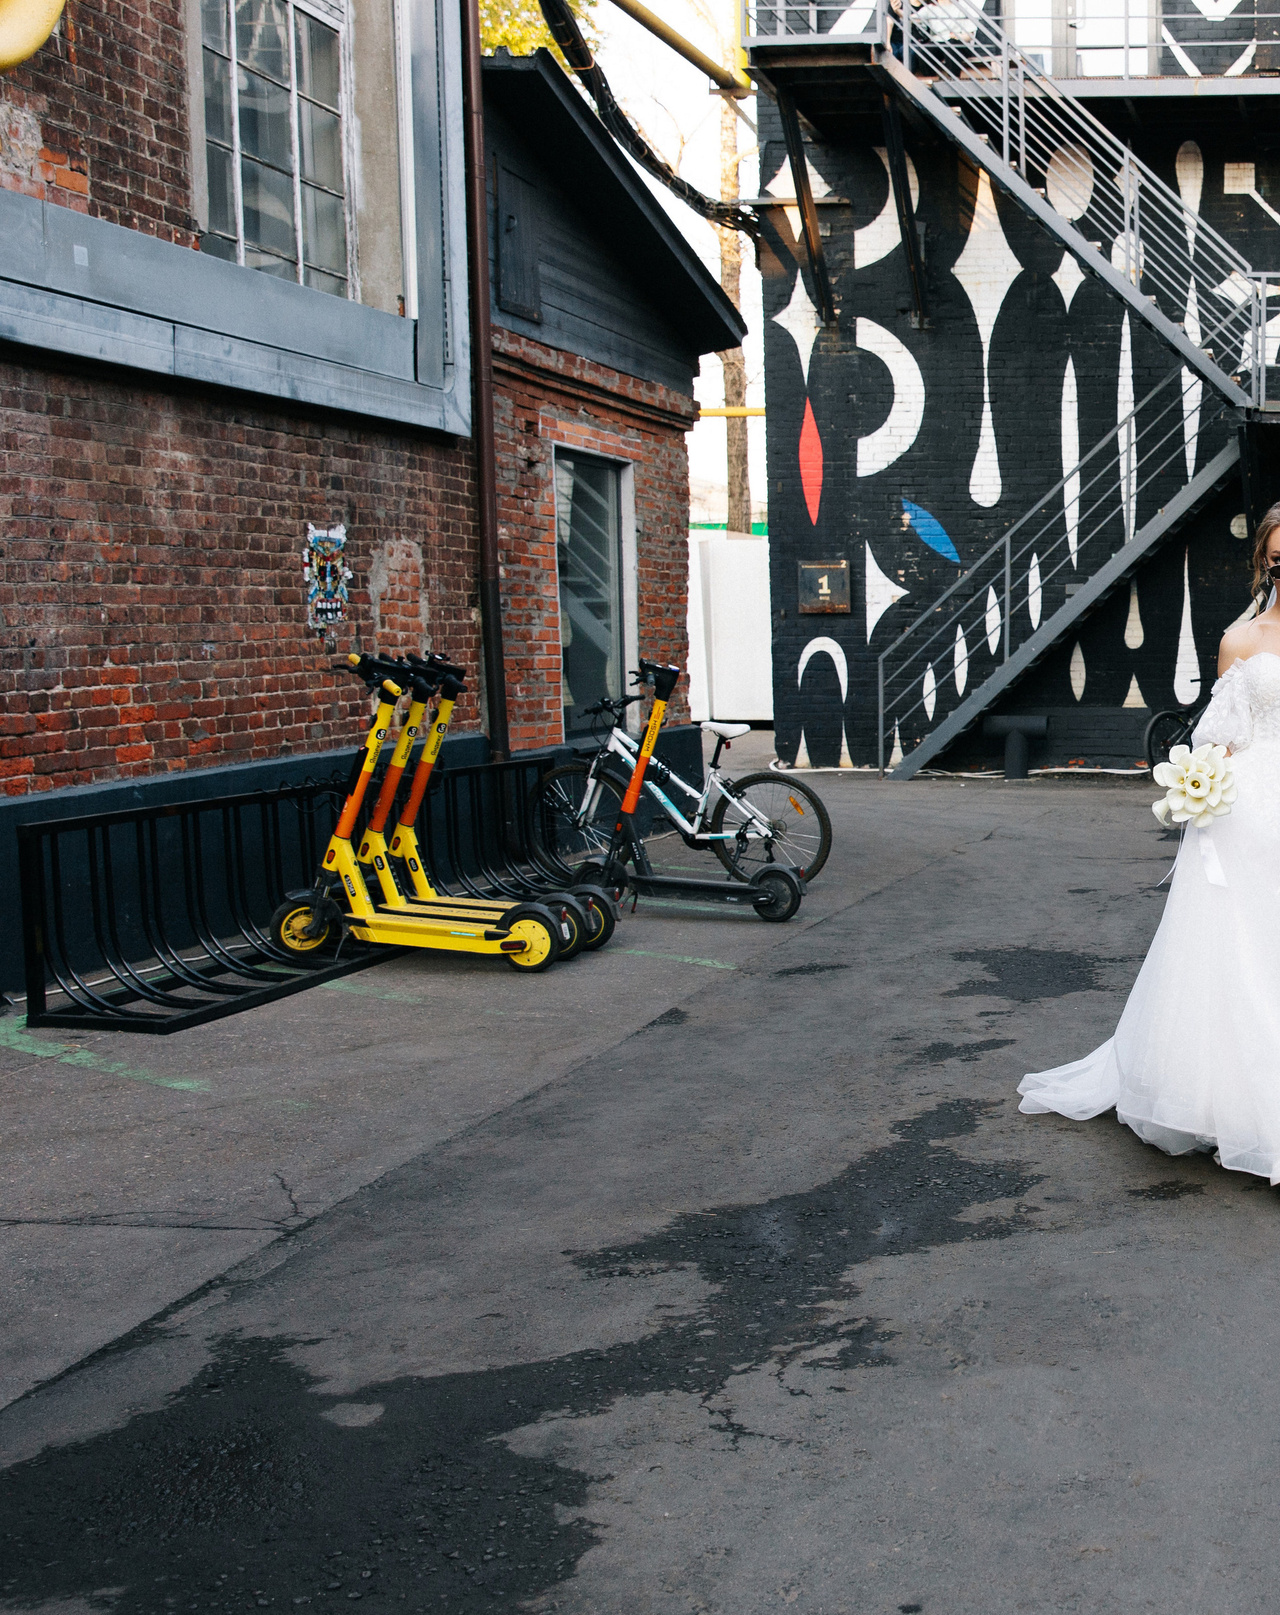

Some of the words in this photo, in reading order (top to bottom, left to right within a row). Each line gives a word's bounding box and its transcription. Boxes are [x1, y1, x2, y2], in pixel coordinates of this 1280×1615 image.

[840, 560, 847, 568] 2
[818, 574, 831, 594] 1
[408, 727, 417, 737] Go
[438, 724, 446, 733] Go
[377, 729, 386, 739] Go
[645, 720, 657, 752] WHOOSH
